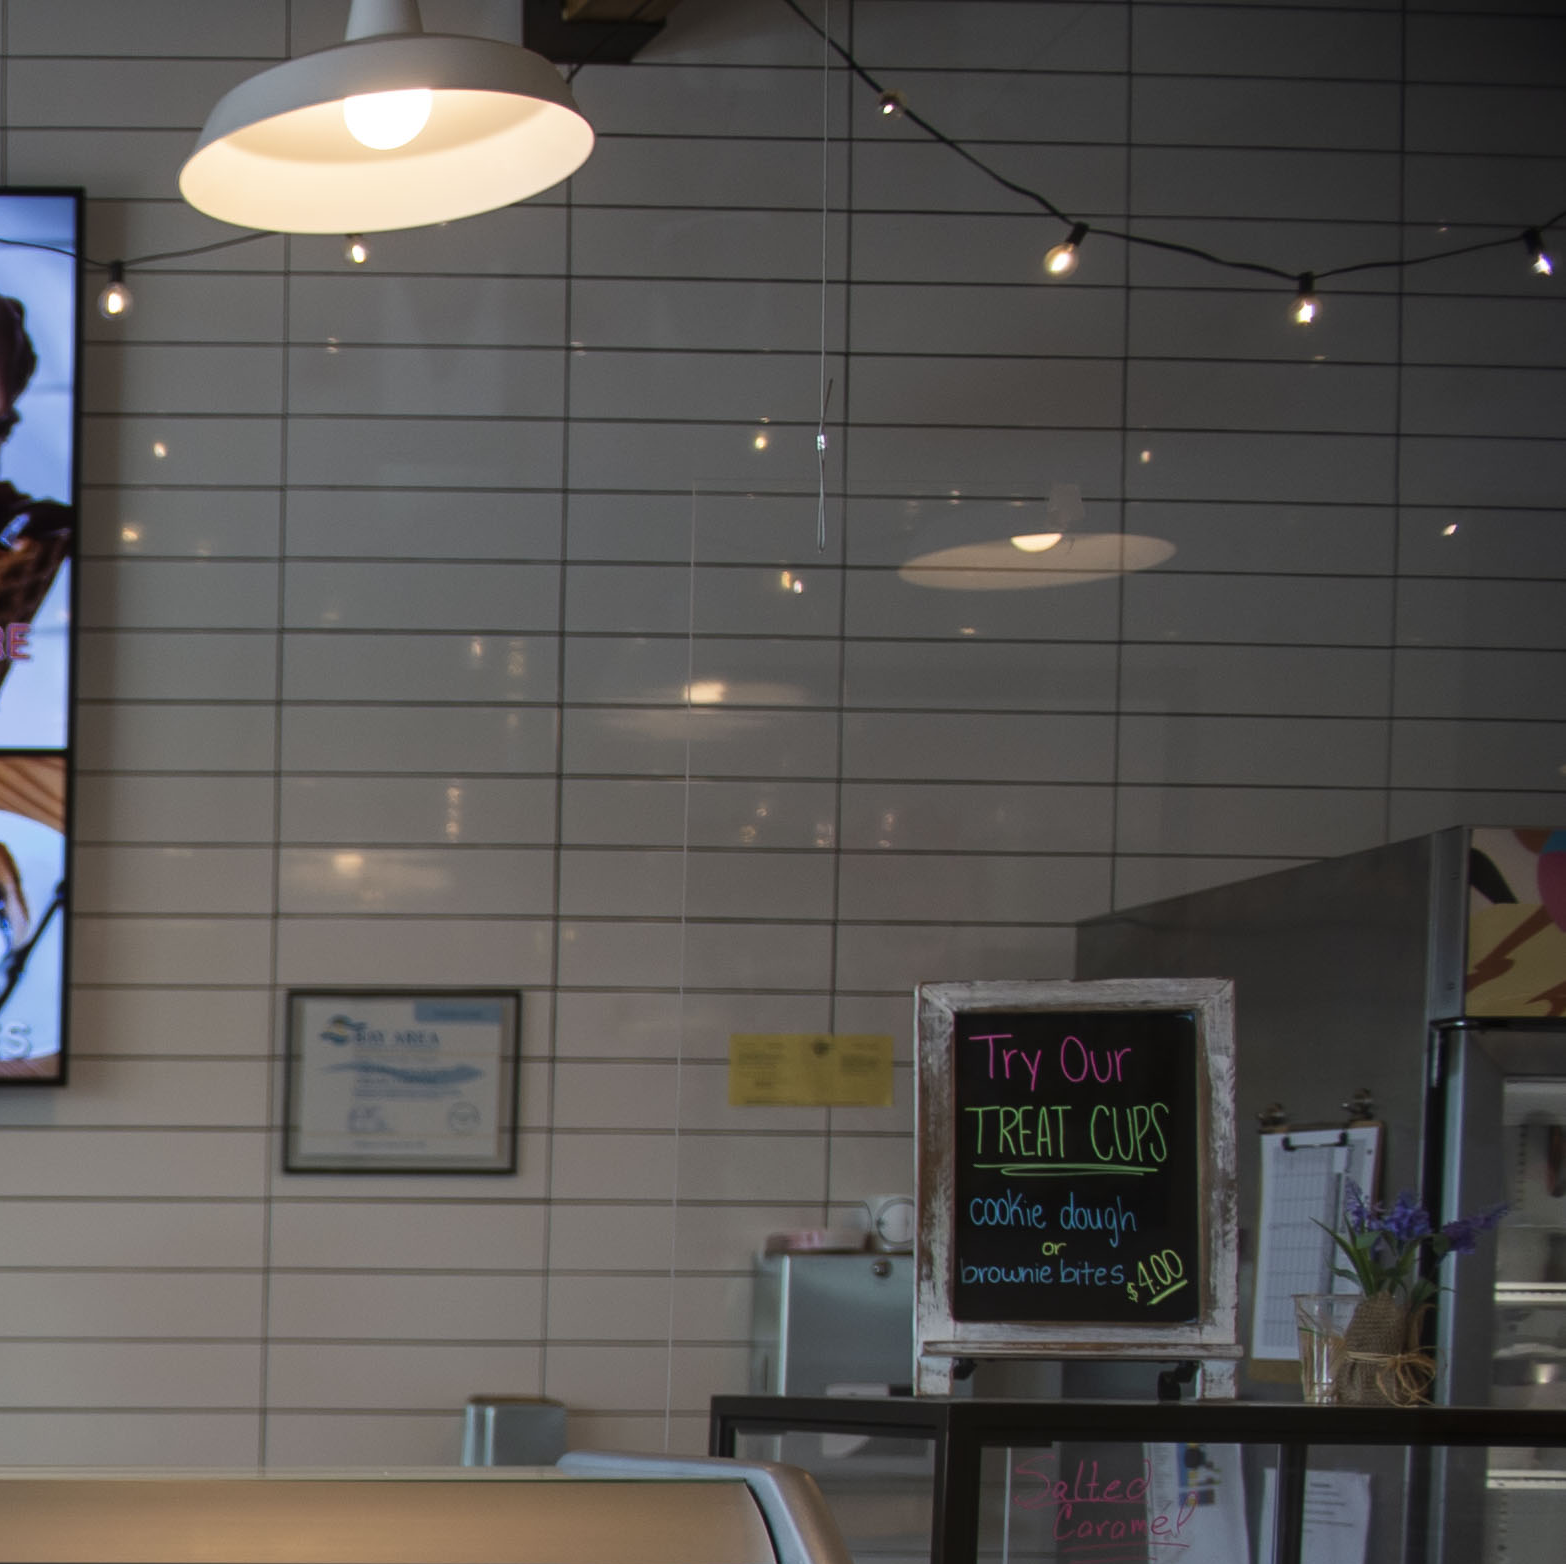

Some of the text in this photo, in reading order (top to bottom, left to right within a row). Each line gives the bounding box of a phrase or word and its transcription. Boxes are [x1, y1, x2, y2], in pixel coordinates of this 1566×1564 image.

[969, 1034, 1132, 1091] Try Our
[965, 1102, 1168, 1162] TREAT CUPS
[970, 1189, 1136, 1247] cookie dough
[961, 1258, 1124, 1286] brownie bites
[1042, 1242, 1066, 1256] or
[1127, 1249, 1183, 1302] $4.00
